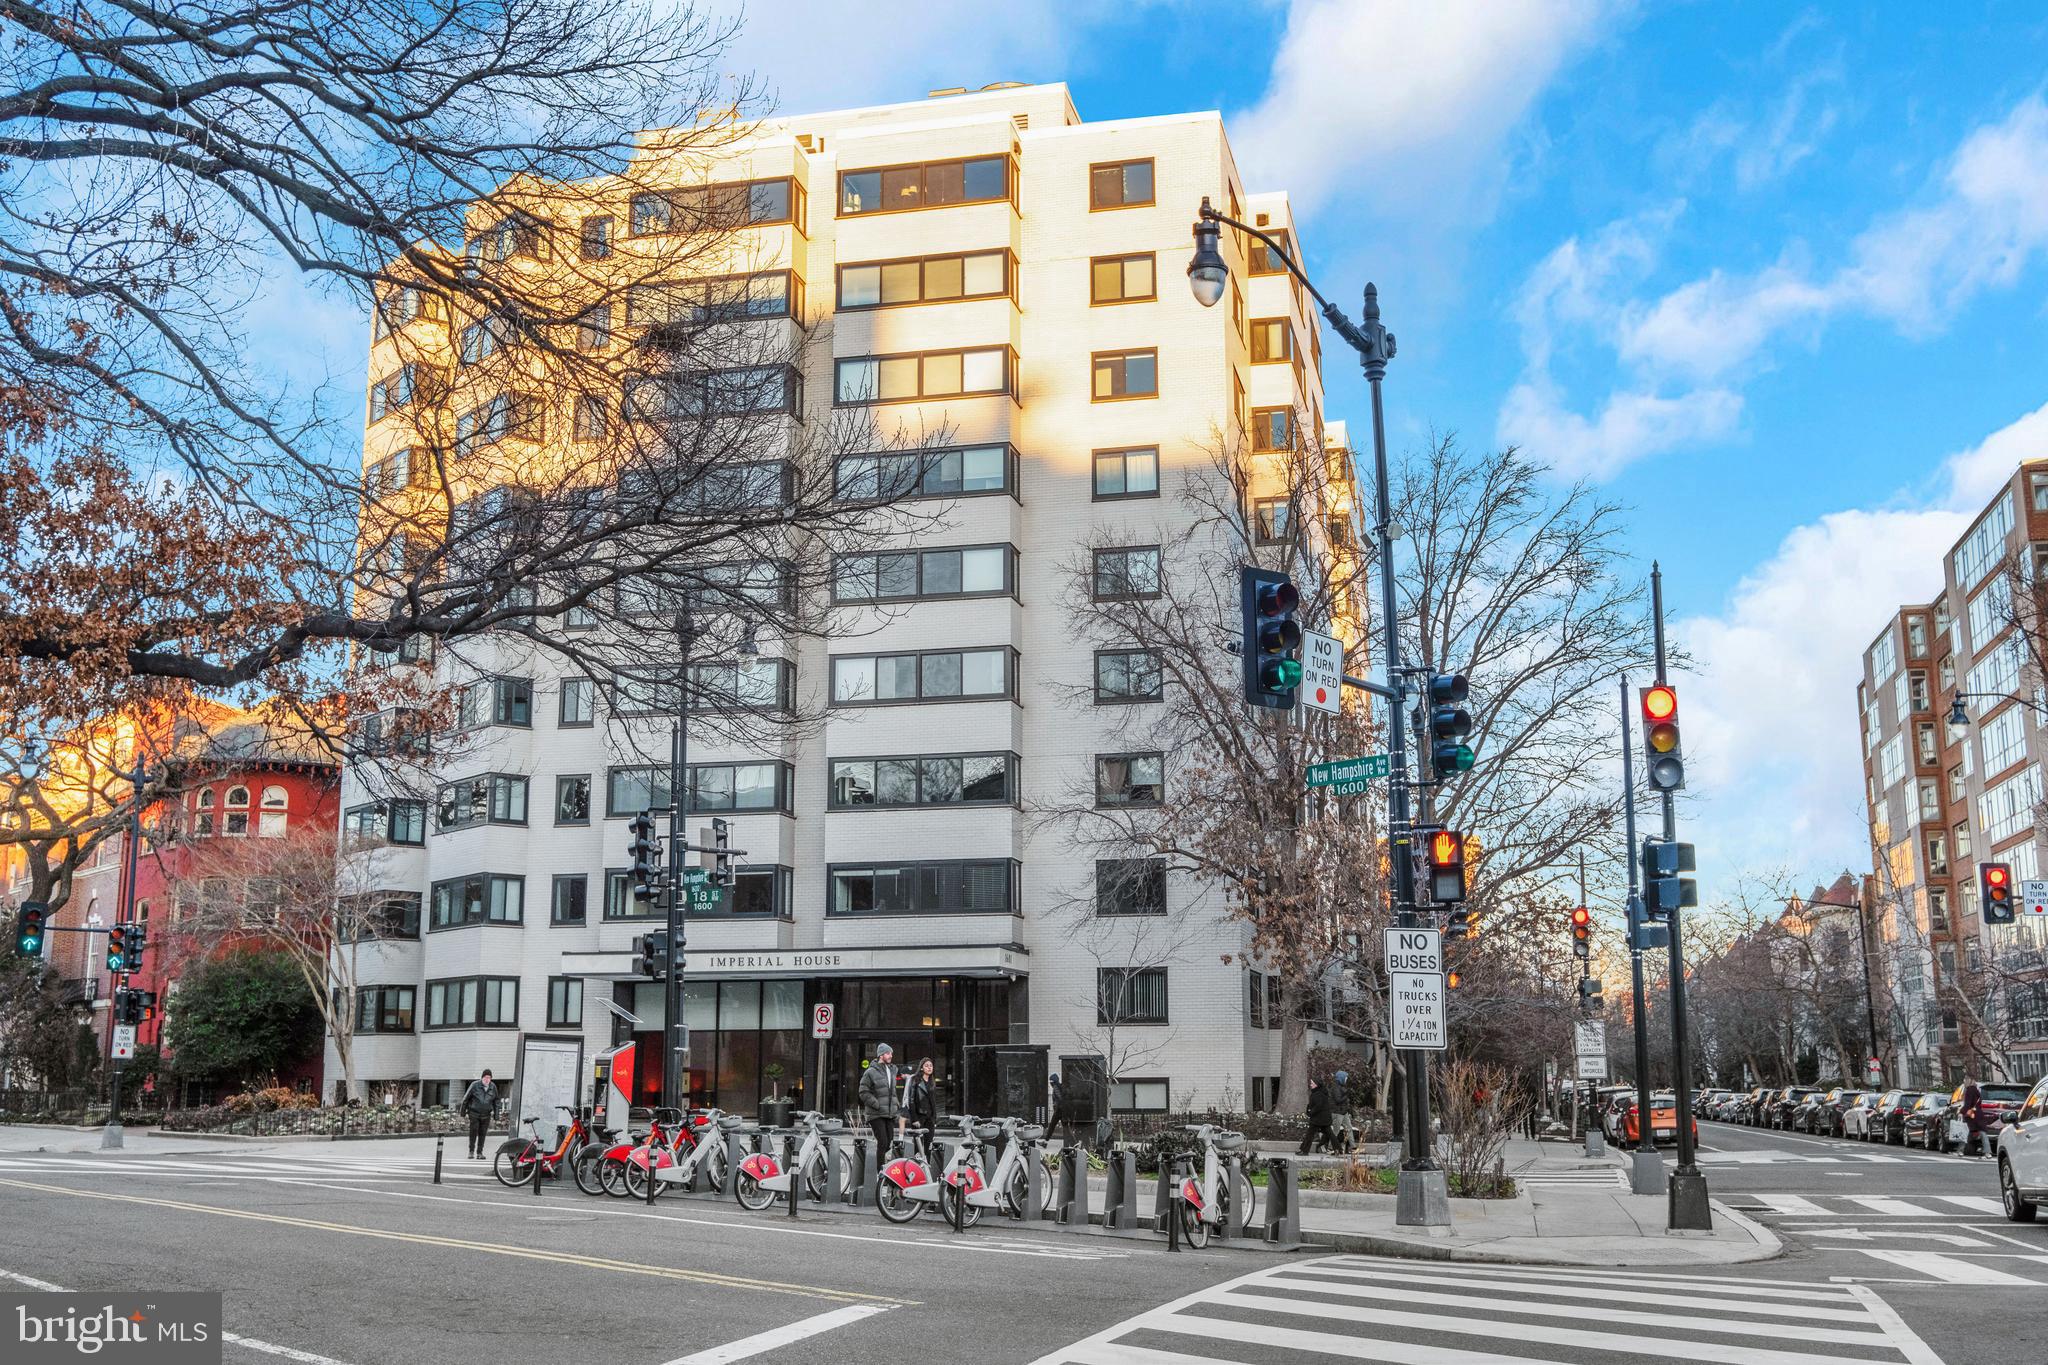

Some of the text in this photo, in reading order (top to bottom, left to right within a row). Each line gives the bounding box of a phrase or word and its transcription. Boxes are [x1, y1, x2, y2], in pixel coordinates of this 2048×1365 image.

[1315, 639, 1331, 656] NO
[1312, 656, 1334, 672] TURN
[1306, 670, 1338, 688] ON RED
[1376, 758, 1386, 766] Ave
[1312, 760, 1374, 783] New Hampshire
[1336, 781, 1364, 795] 1600
[693, 891, 707, 901] 18
[1400, 934, 1428, 950] NO
[710, 955, 841, 967] IMPERIAL HOUSE
[1390, 955, 1437, 969] BUSES
[1412, 979, 1424, 988] NO
[1399, 991, 1437, 1001] TRUCKS
[1406, 1005, 1432, 1015] OVER
[1424, 1021, 1437, 1030] TON
[1399, 1032, 1438, 1041] CAPACITY
